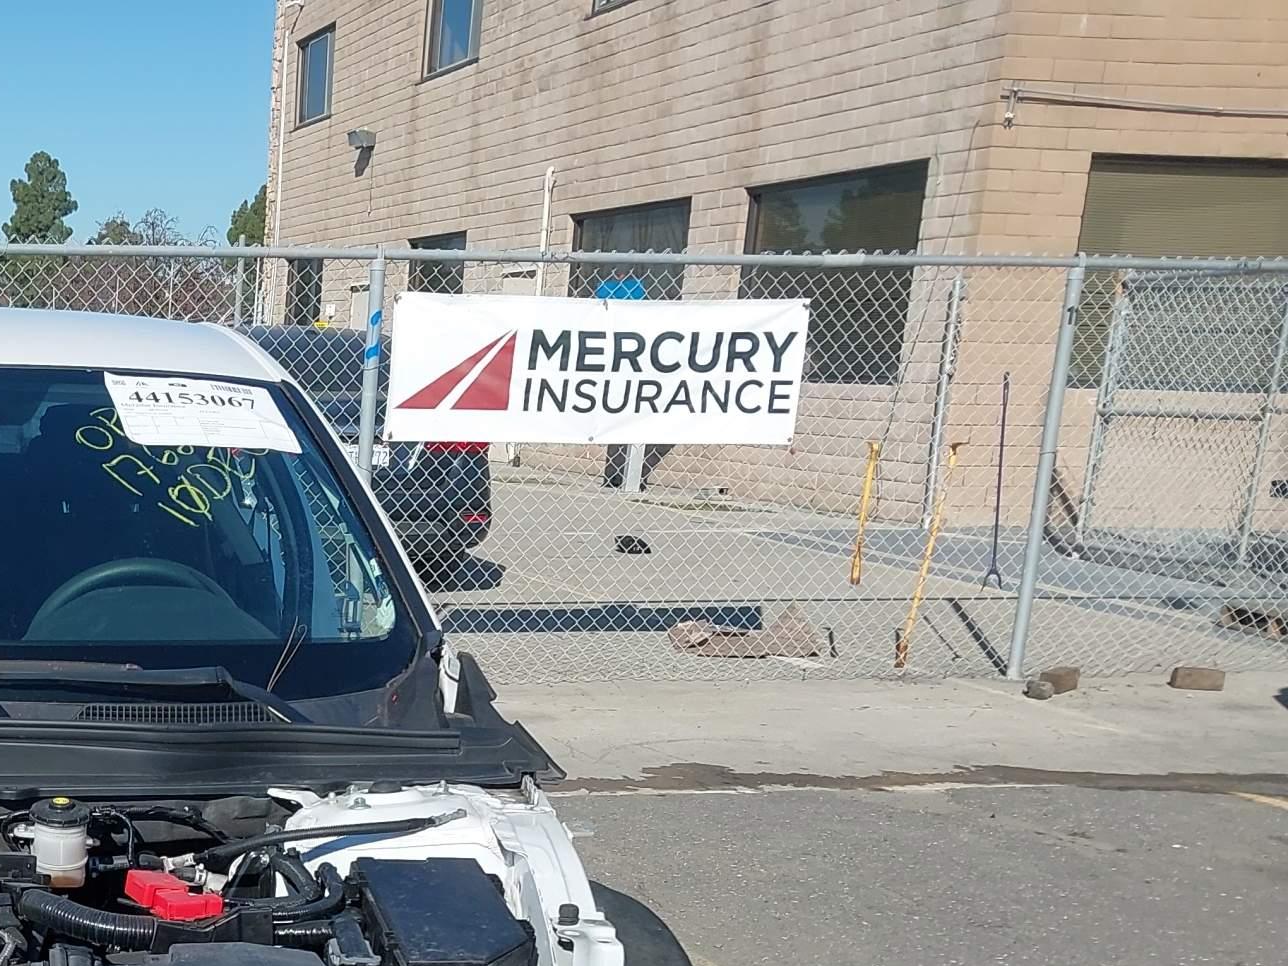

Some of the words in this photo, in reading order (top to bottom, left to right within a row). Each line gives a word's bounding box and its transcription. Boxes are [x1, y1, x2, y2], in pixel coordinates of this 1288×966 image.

[527, 328, 799, 374] MERCURY
[129, 390, 255, 410] 44153067
[522, 377, 795, 414] INSURANCE
